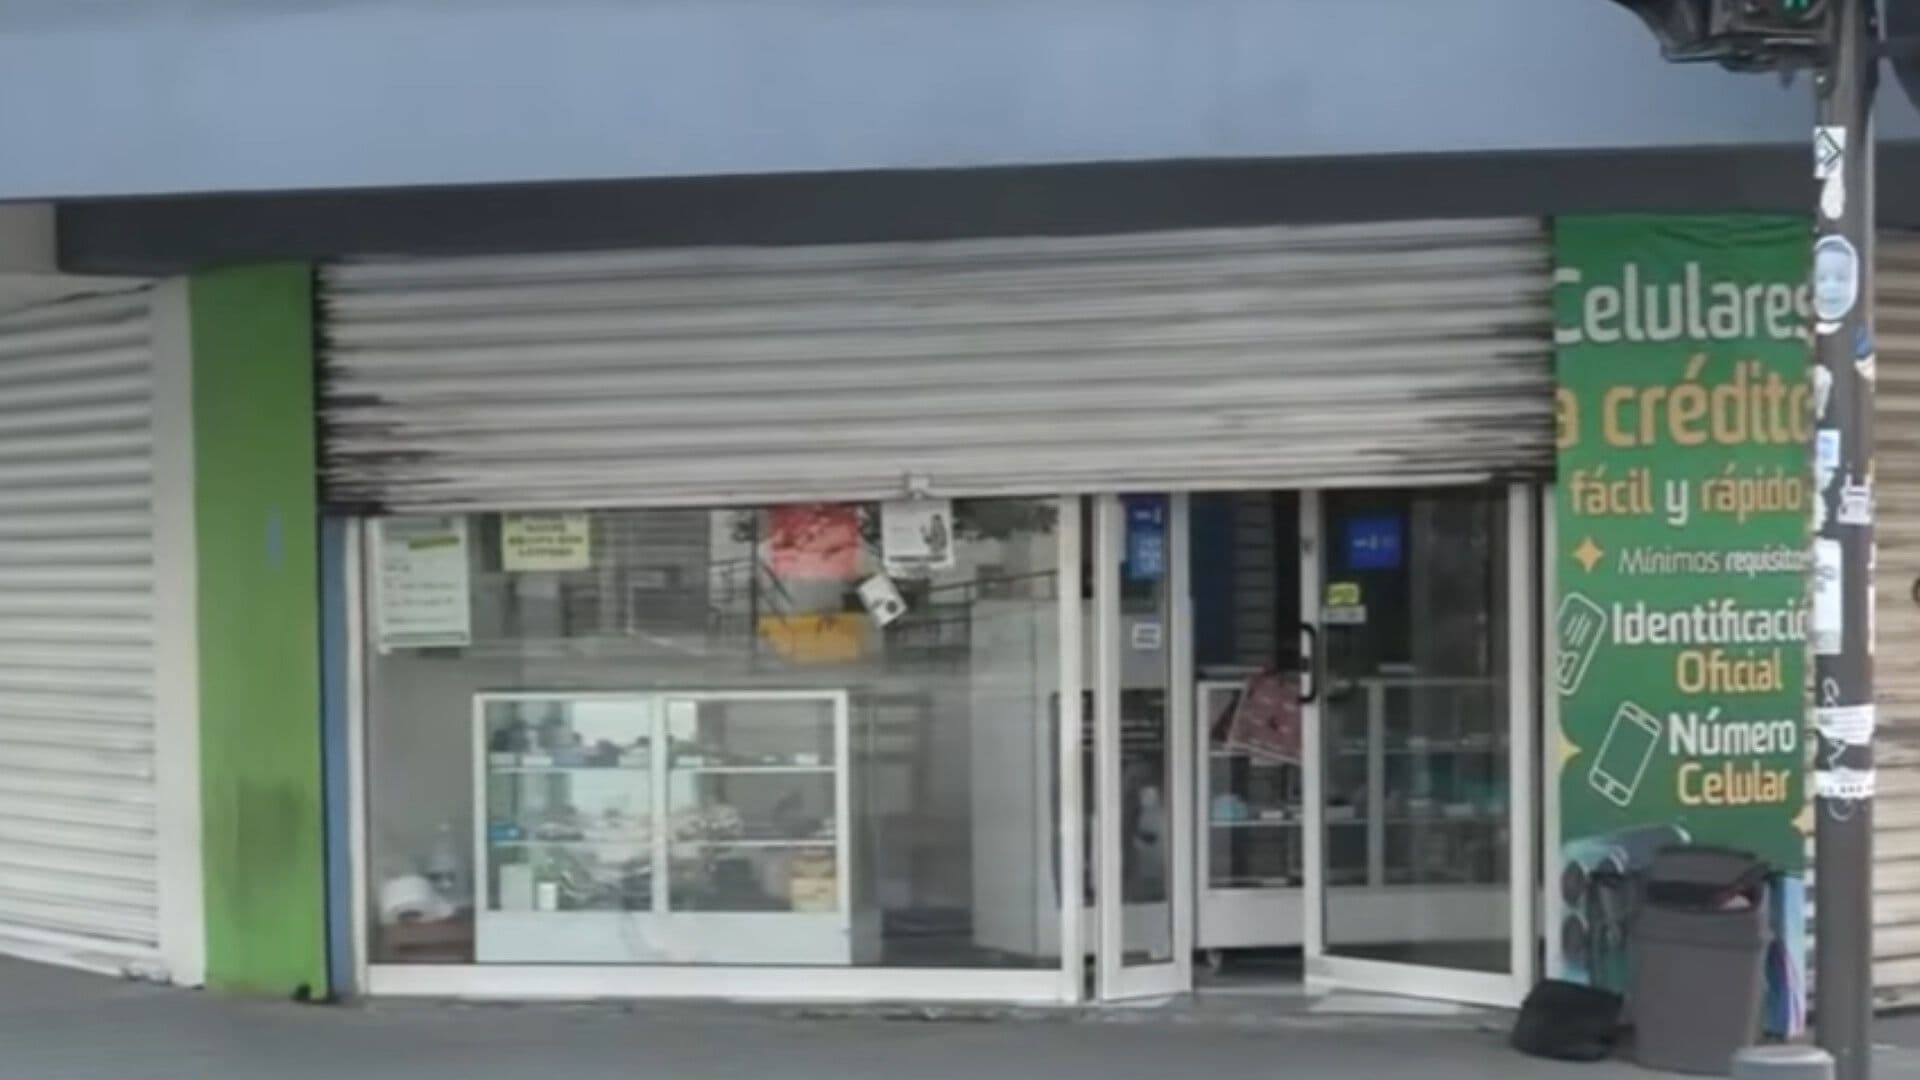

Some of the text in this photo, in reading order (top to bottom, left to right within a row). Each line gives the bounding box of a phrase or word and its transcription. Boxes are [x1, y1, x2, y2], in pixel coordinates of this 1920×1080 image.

[1570, 463, 1802, 526] fácil y rápido
[1618, 545, 1720, 574] Mínimos
[1677, 647, 1783, 694] Oficial
[1669, 706, 1797, 756] Número
[1678, 760, 1791, 806] Celular
